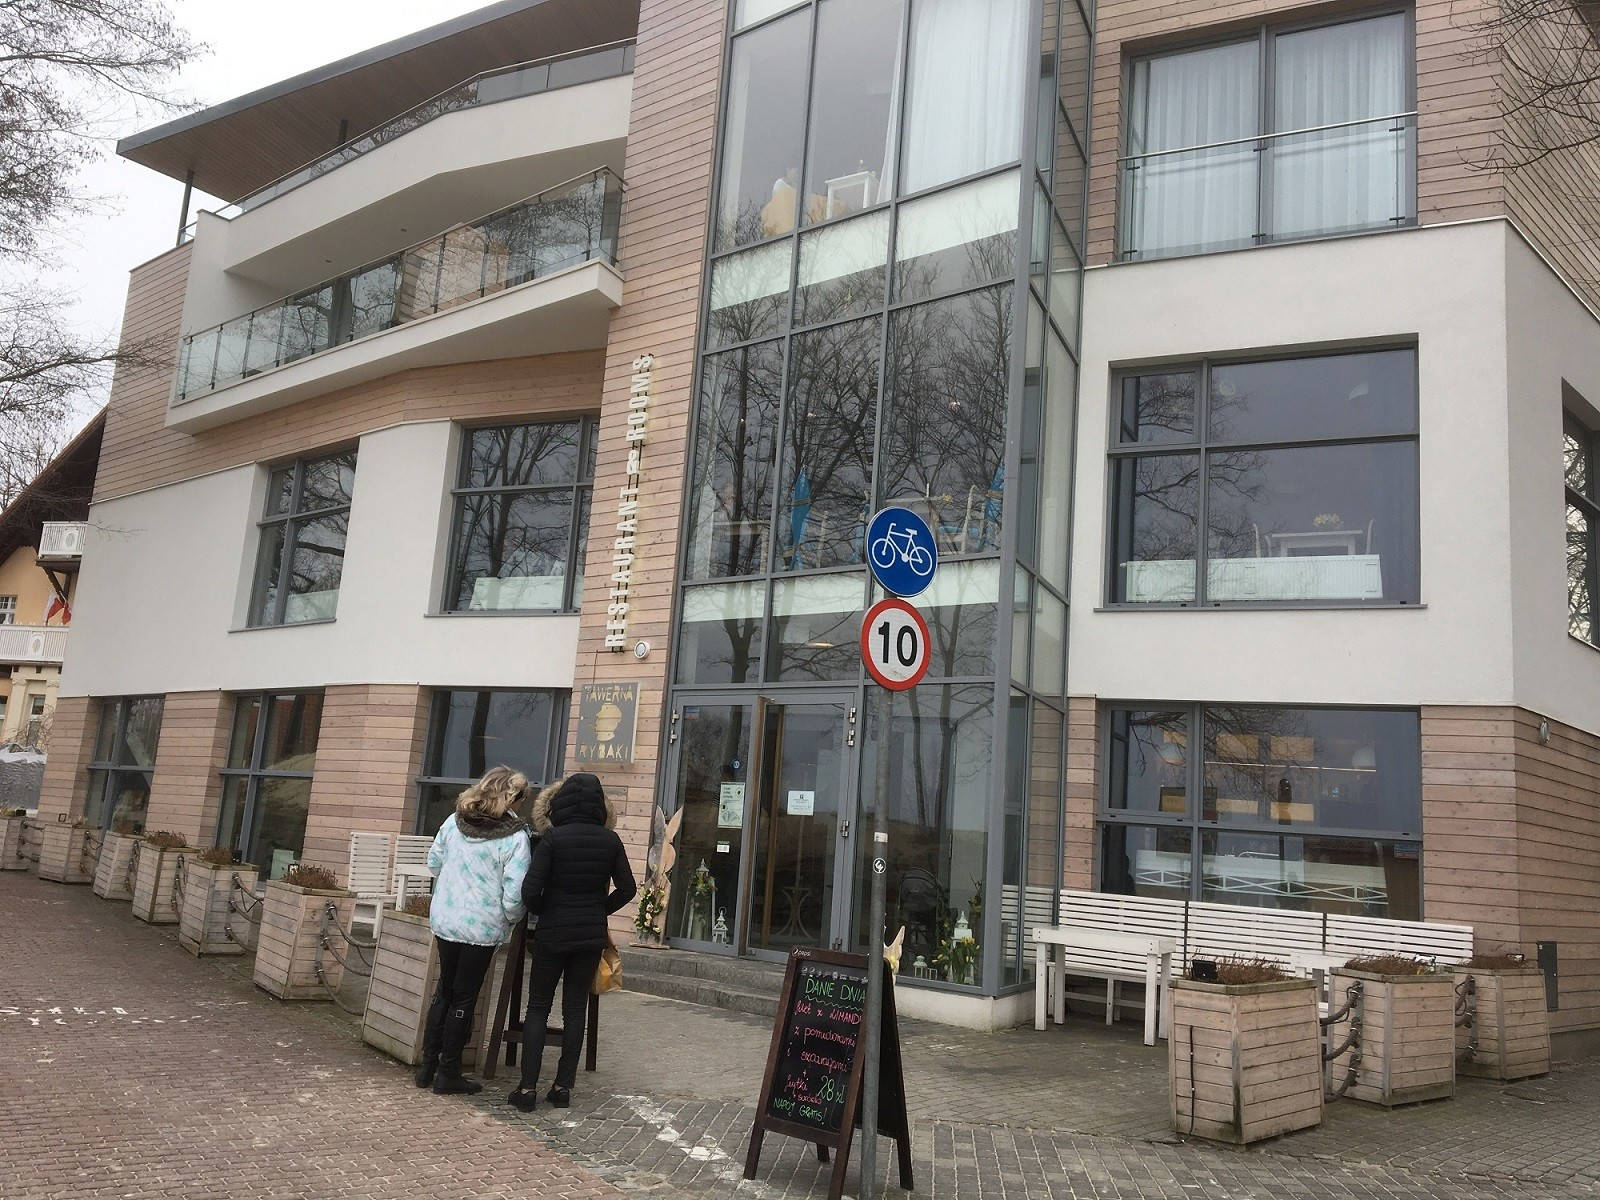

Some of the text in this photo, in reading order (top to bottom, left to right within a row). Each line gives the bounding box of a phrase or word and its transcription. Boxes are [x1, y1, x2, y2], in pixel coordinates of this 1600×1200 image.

[604, 487, 640, 648] RESTAURANT
[625, 353, 653, 442] ROOMS
[878, 621, 918, 667] 10
[584, 684, 633, 703] TAWERNA
[579, 743, 629, 760] RYBAKI
[805, 978, 866, 1003] DANIE DNIA
[829, 1009, 862, 1025] LIMAND
[803, 1027, 857, 1048] pomidorami
[816, 1075, 835, 1102] 28
[799, 1104, 828, 1126] GRATIS!
